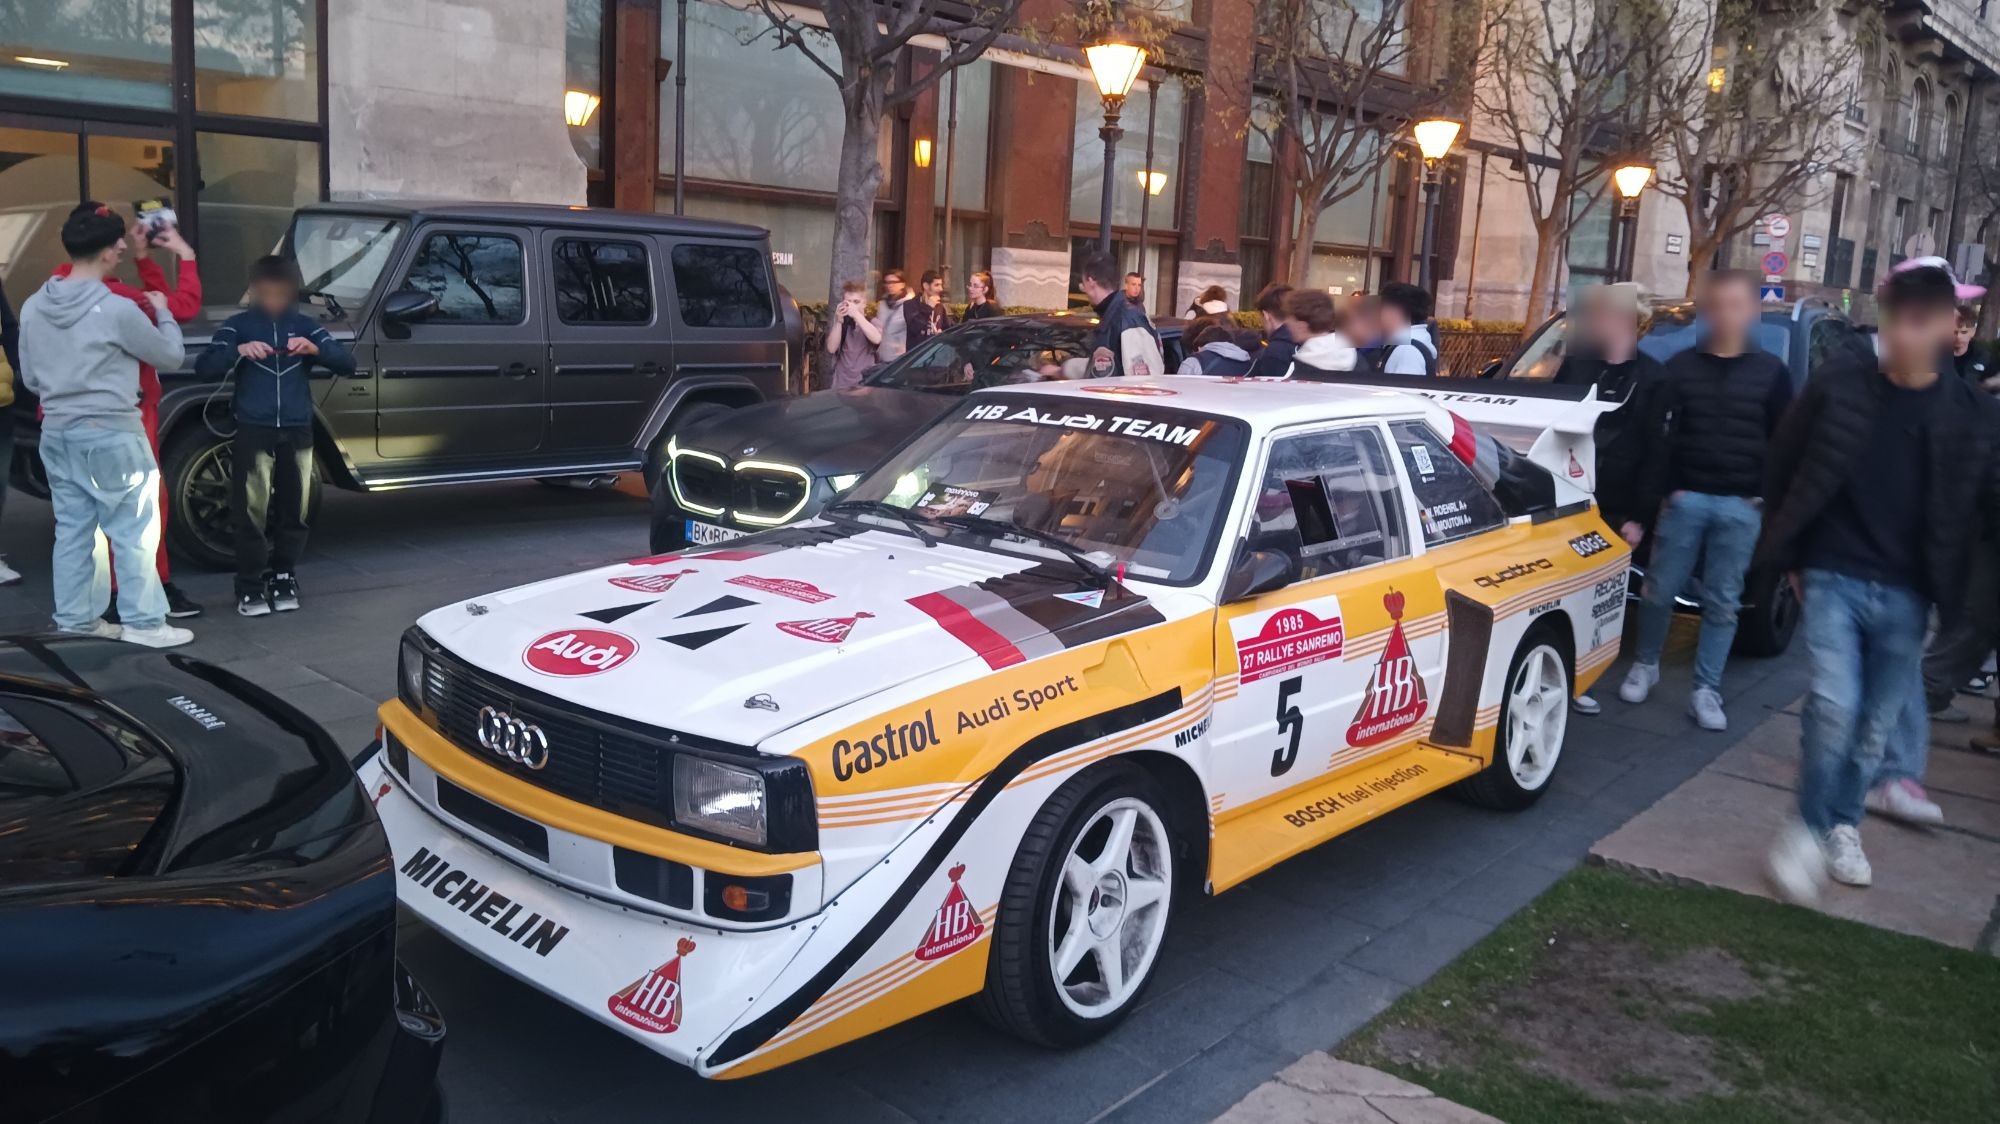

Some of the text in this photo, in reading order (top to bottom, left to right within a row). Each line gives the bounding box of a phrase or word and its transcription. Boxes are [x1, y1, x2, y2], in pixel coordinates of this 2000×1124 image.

[1443, 393, 1518, 406] TEAM
[966, 405, 1008, 420] HB
[1108, 416, 1201, 446] TEAM
[1571, 533, 1609, 556] BOGE
[1473, 558, 1553, 588] quattro
[1594, 571, 1626, 600] RECARO
[1276, 614, 1303, 634] 1985
[1529, 599, 1562, 616] MICHELIN
[799, 618, 852, 636] HB
[533, 633, 623, 669] Audi
[1243, 631, 1340, 669] 27 RALLYE SANREMO
[956, 674, 1079, 735] Audi Sport
[1370, 655, 1414, 719] HB
[1271, 675, 1304, 777] 5
[1356, 708, 1417, 741] international
[831, 709, 941, 782] Castrol
[1283, 762, 1428, 828] BOSCH fuel injection
[400, 846, 570, 958] MICHELIN
[934, 899, 969, 943] HB
[924, 928, 976, 957] international
[630, 969, 680, 1018] HB
[614, 1001, 669, 1031] international
